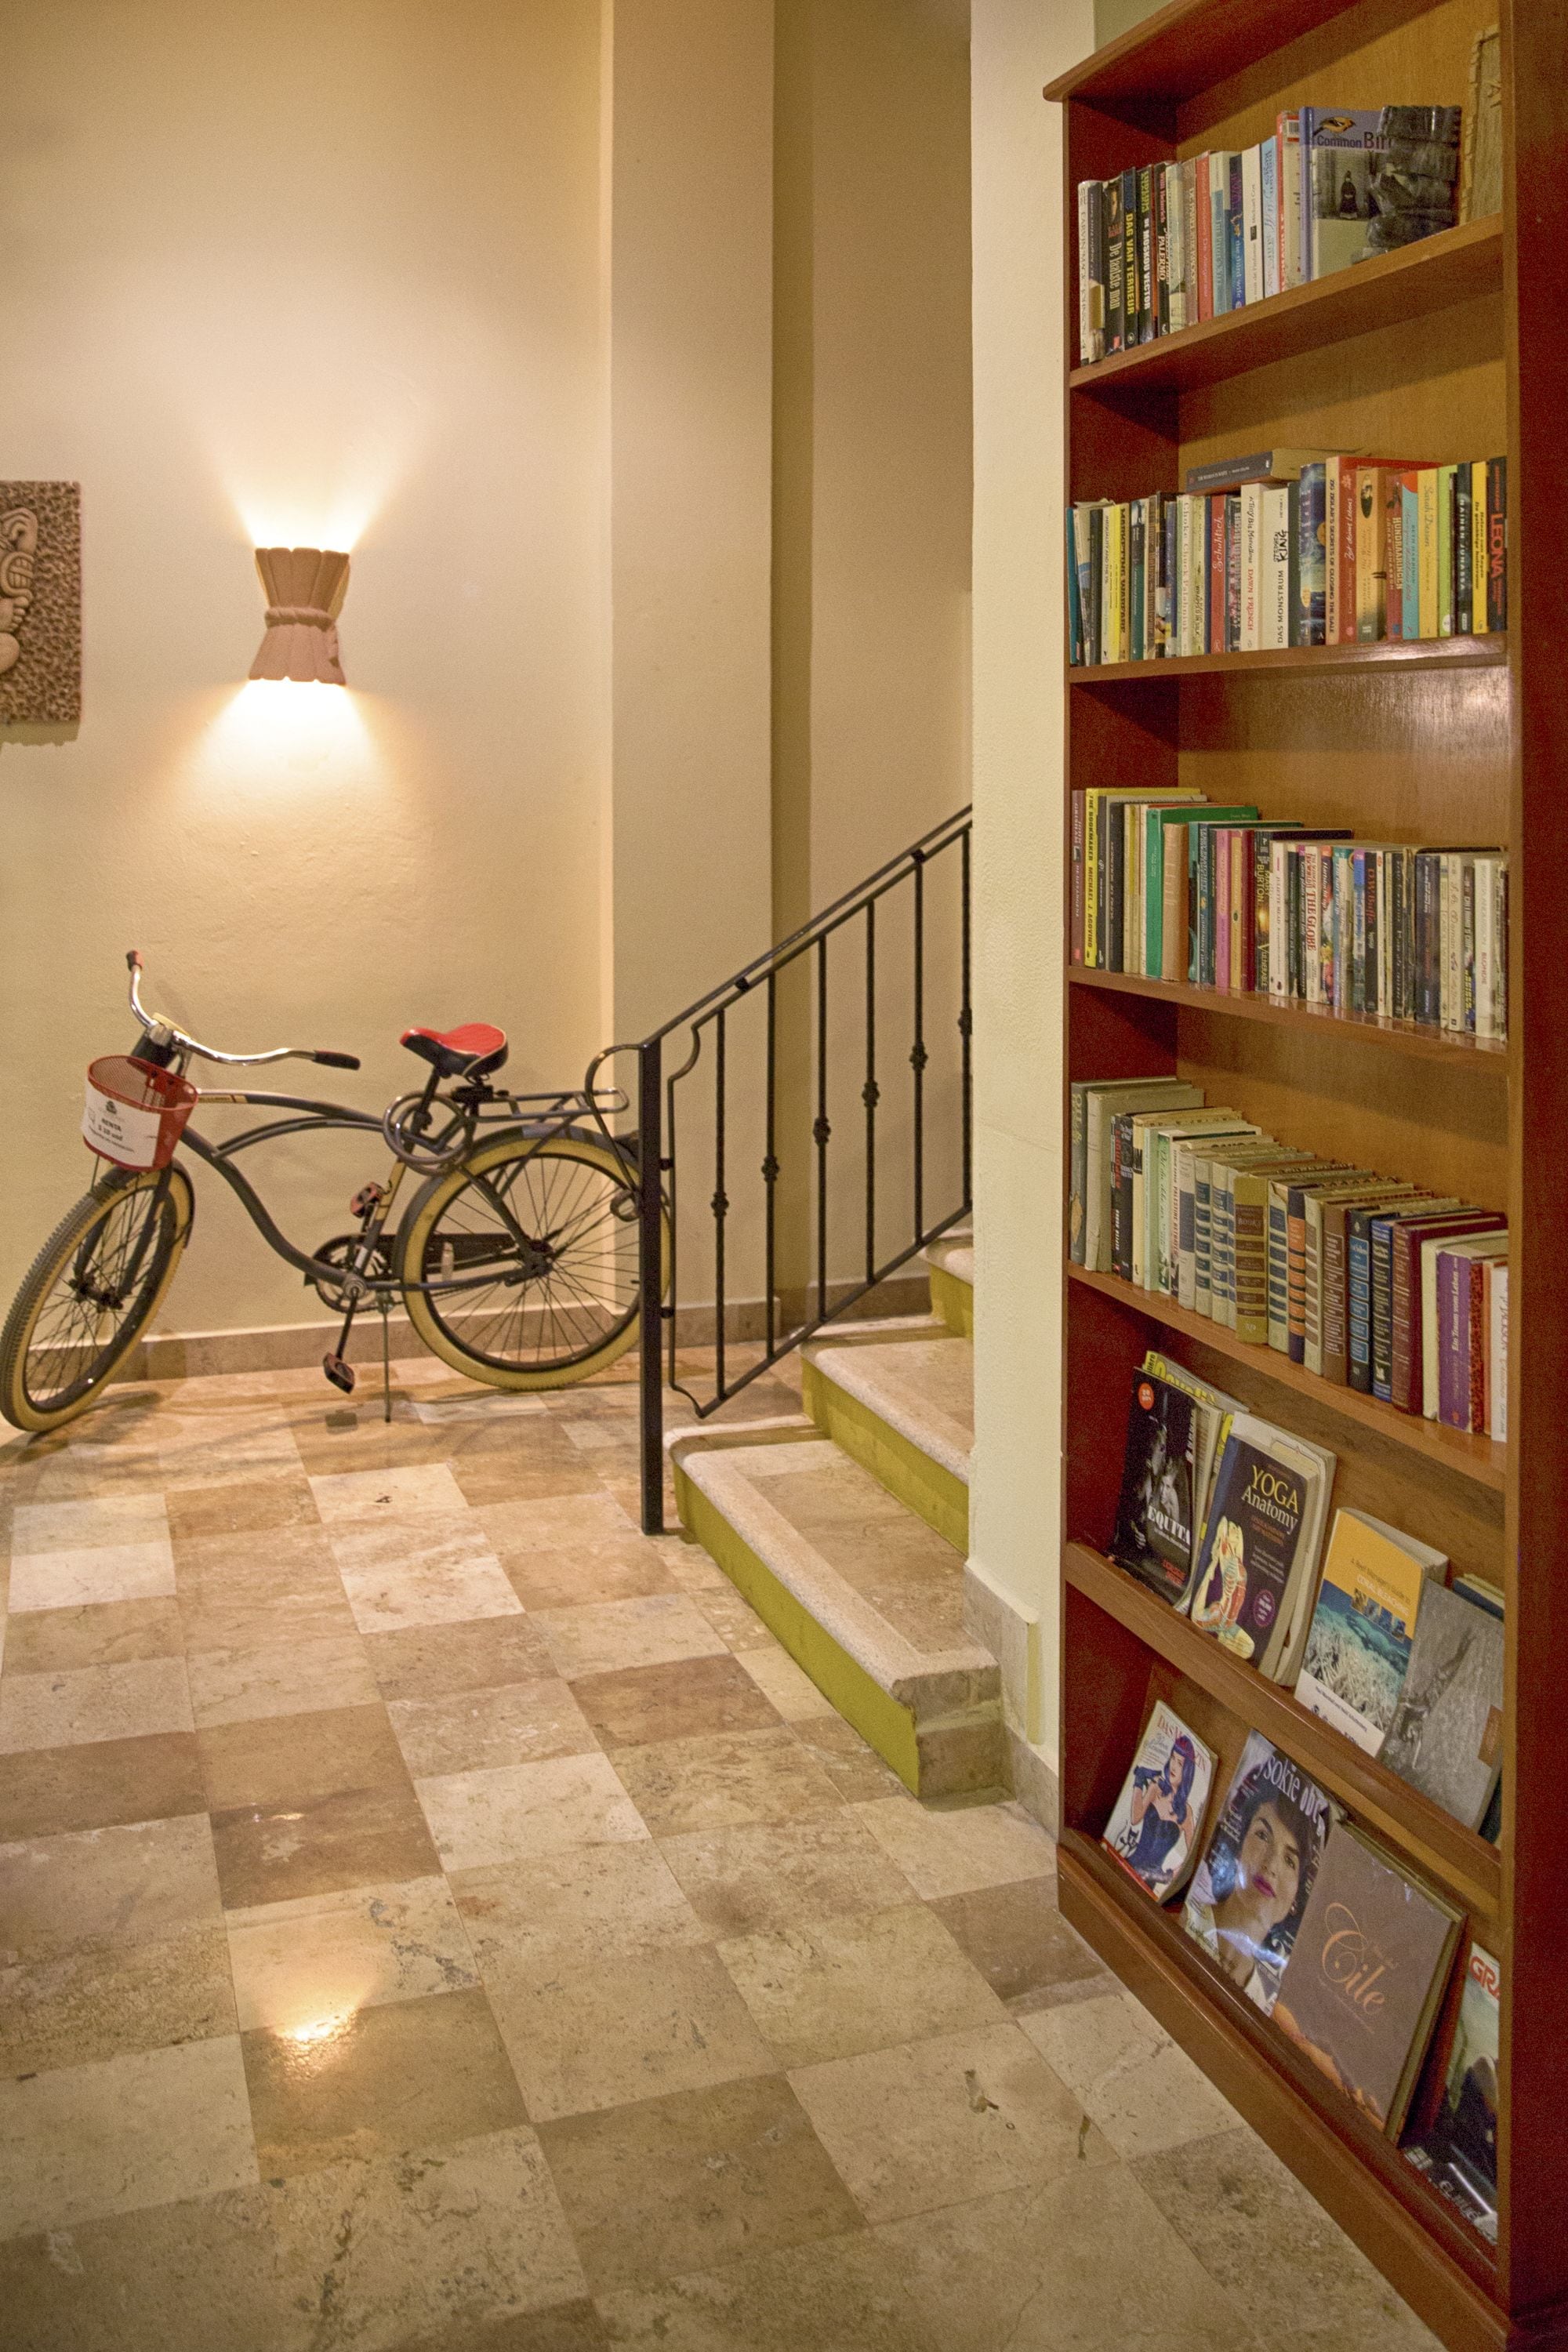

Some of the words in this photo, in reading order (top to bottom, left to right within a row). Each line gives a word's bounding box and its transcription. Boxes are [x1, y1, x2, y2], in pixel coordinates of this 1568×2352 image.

[1317, 135, 1362, 148] Common
[1125, 213, 1134, 236] DAG
[1109, 241, 1122, 256] De
[1203, 238, 1210, 250] De
[1109, 258, 1122, 289] laatste
[1109, 290, 1120, 310] man
[1127, 265, 1135, 314] TERREUR
[1247, 502, 1255, 517] Tiny
[1424, 485, 1434, 513] Sarah
[1424, 514, 1434, 547] Dessen
[1278, 529, 1289, 563] KING
[1490, 513, 1504, 579] LEONA
[1329, 557, 1335, 567] OF
[1256, 864, 1265, 902] BURTON
[1306, 891, 1317, 915] THE
[1306, 916, 1317, 951] GLOBE
[1257, 943, 1271, 987] VULNERABLE
[1450, 1271, 1460, 1294] Leben
[1451, 1313, 1460, 1337] Traum
[1451, 1338, 1460, 1352] Ein
[1251, 1465, 1300, 1515] YOGA
[1241, 1485, 1298, 1535] Anatomy
